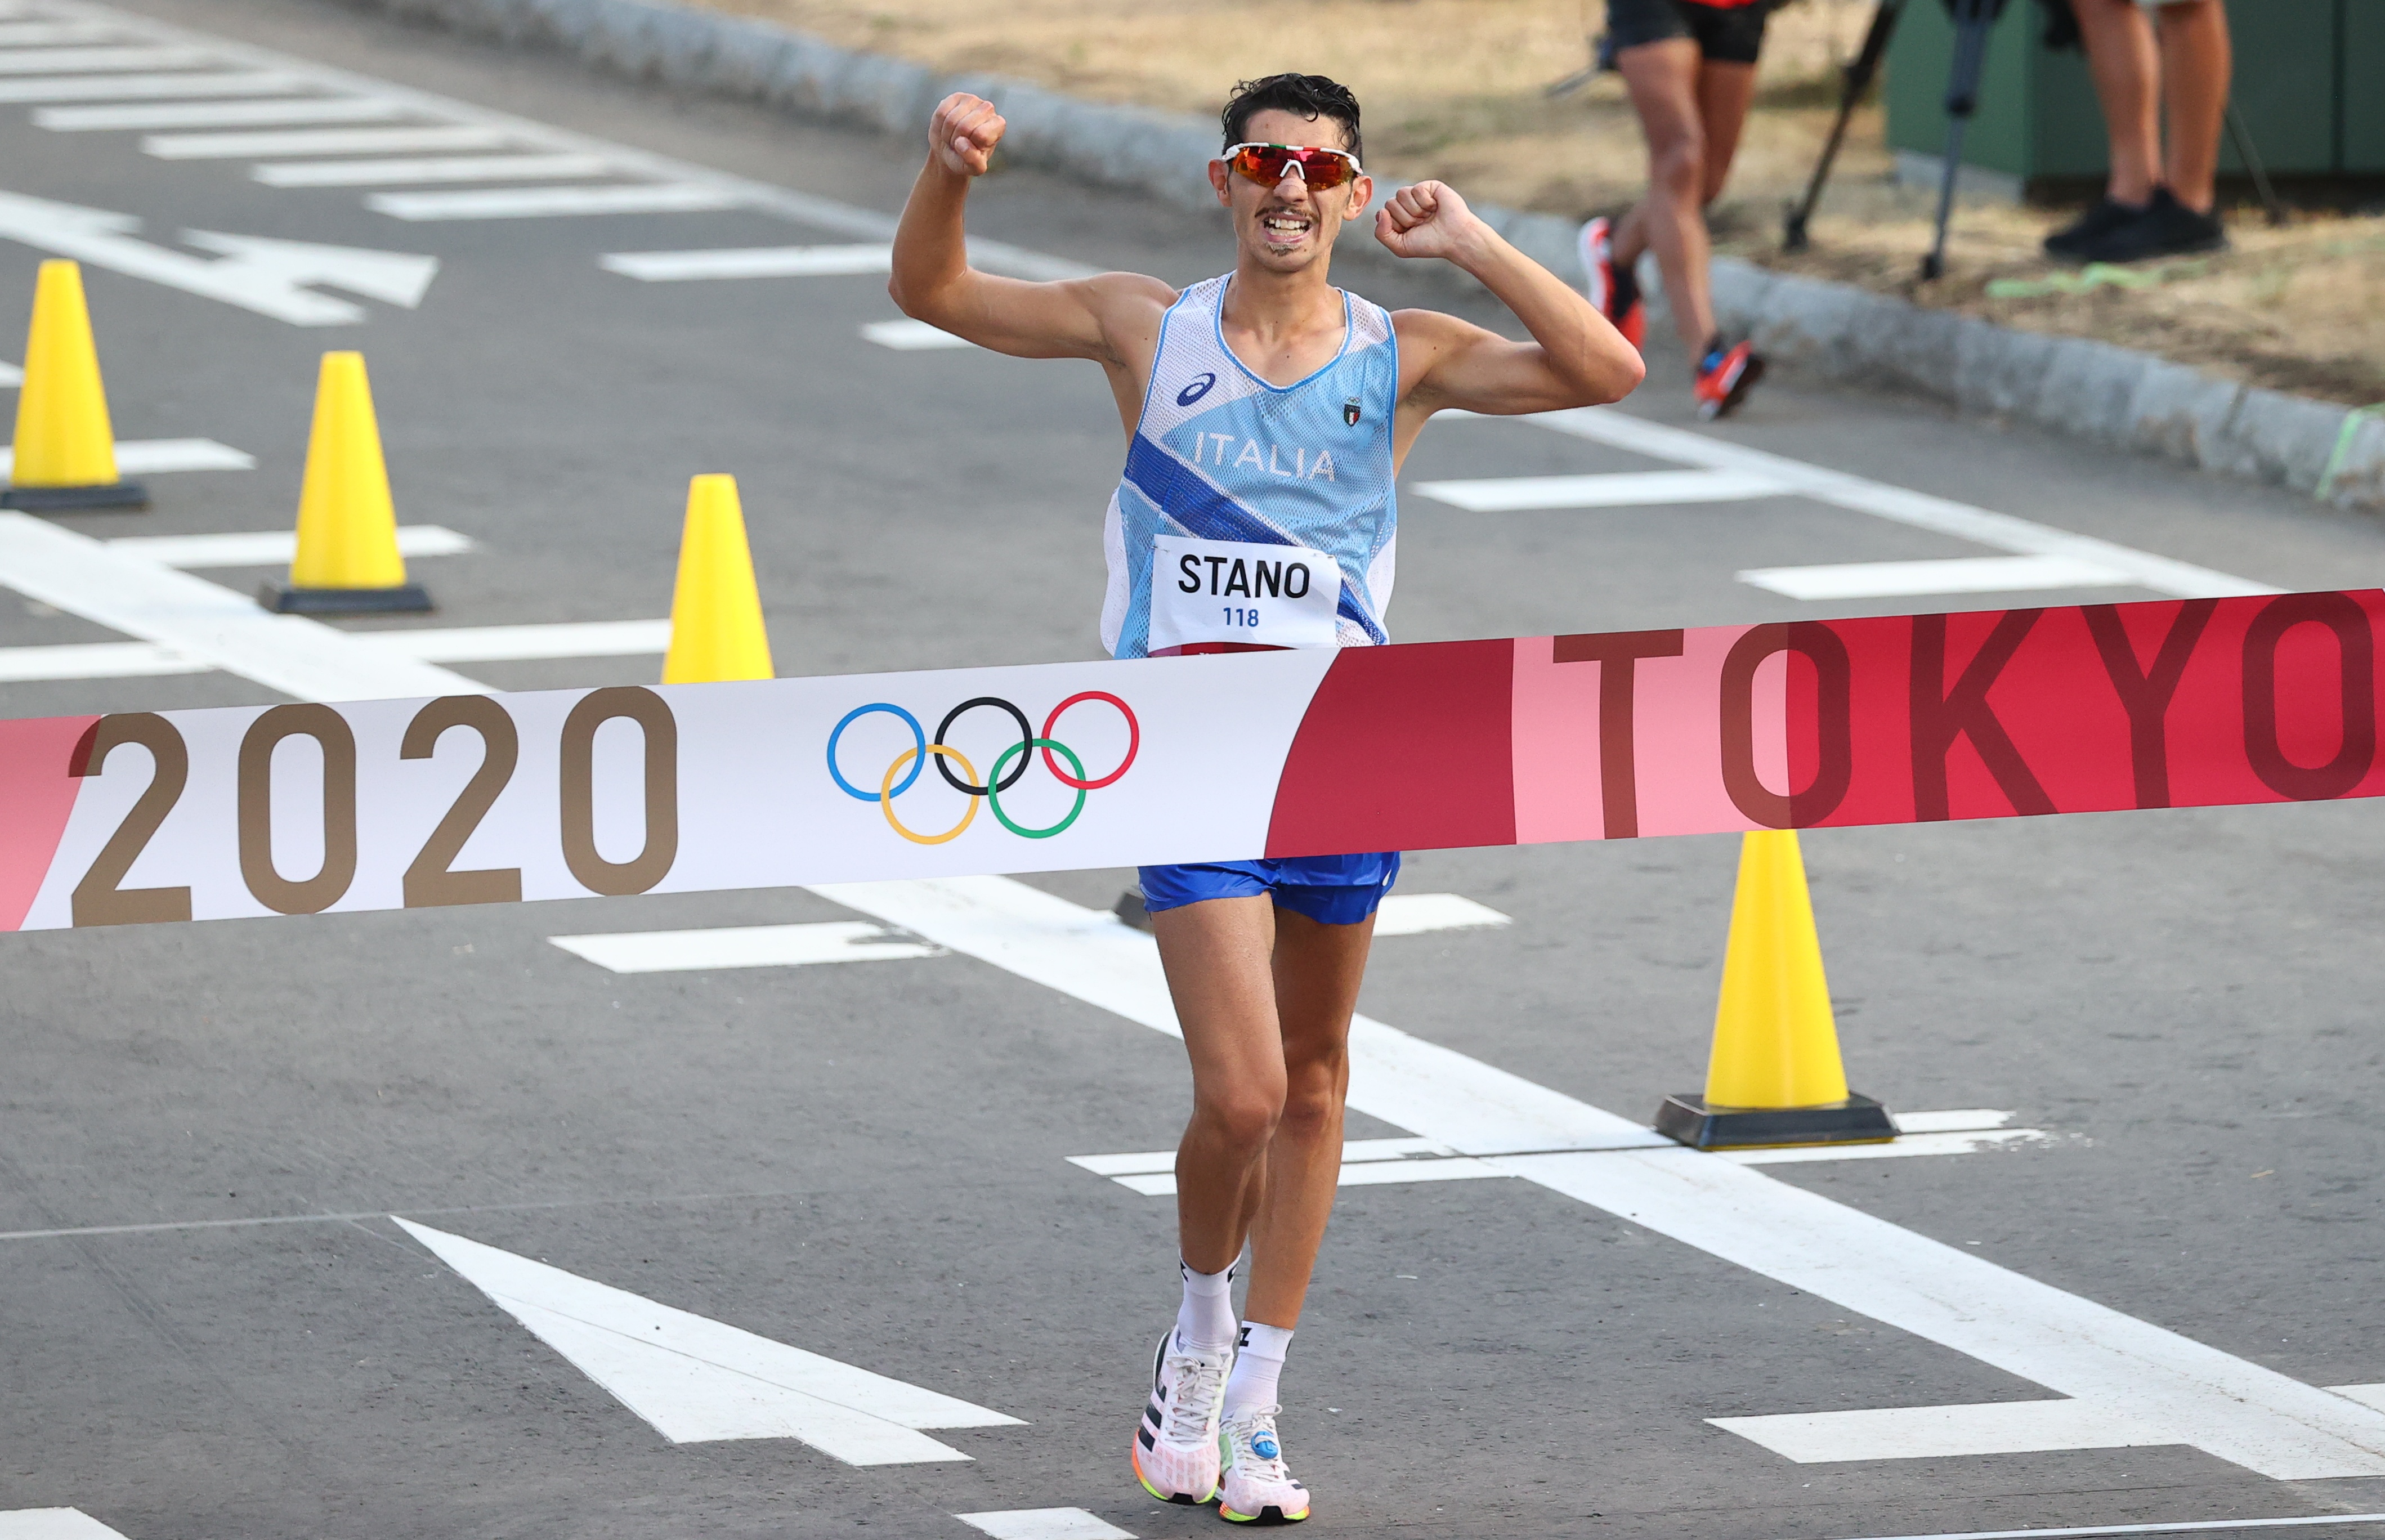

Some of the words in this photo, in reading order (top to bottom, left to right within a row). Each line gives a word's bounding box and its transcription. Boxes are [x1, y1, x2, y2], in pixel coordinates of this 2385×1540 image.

[1194, 431, 1335, 482] ITALIA
[1178, 554, 1310, 598] STANO
[1223, 607, 1259, 627] 118
[1553, 591, 2377, 840] TOKYO
[68, 686, 678, 928] 2020
